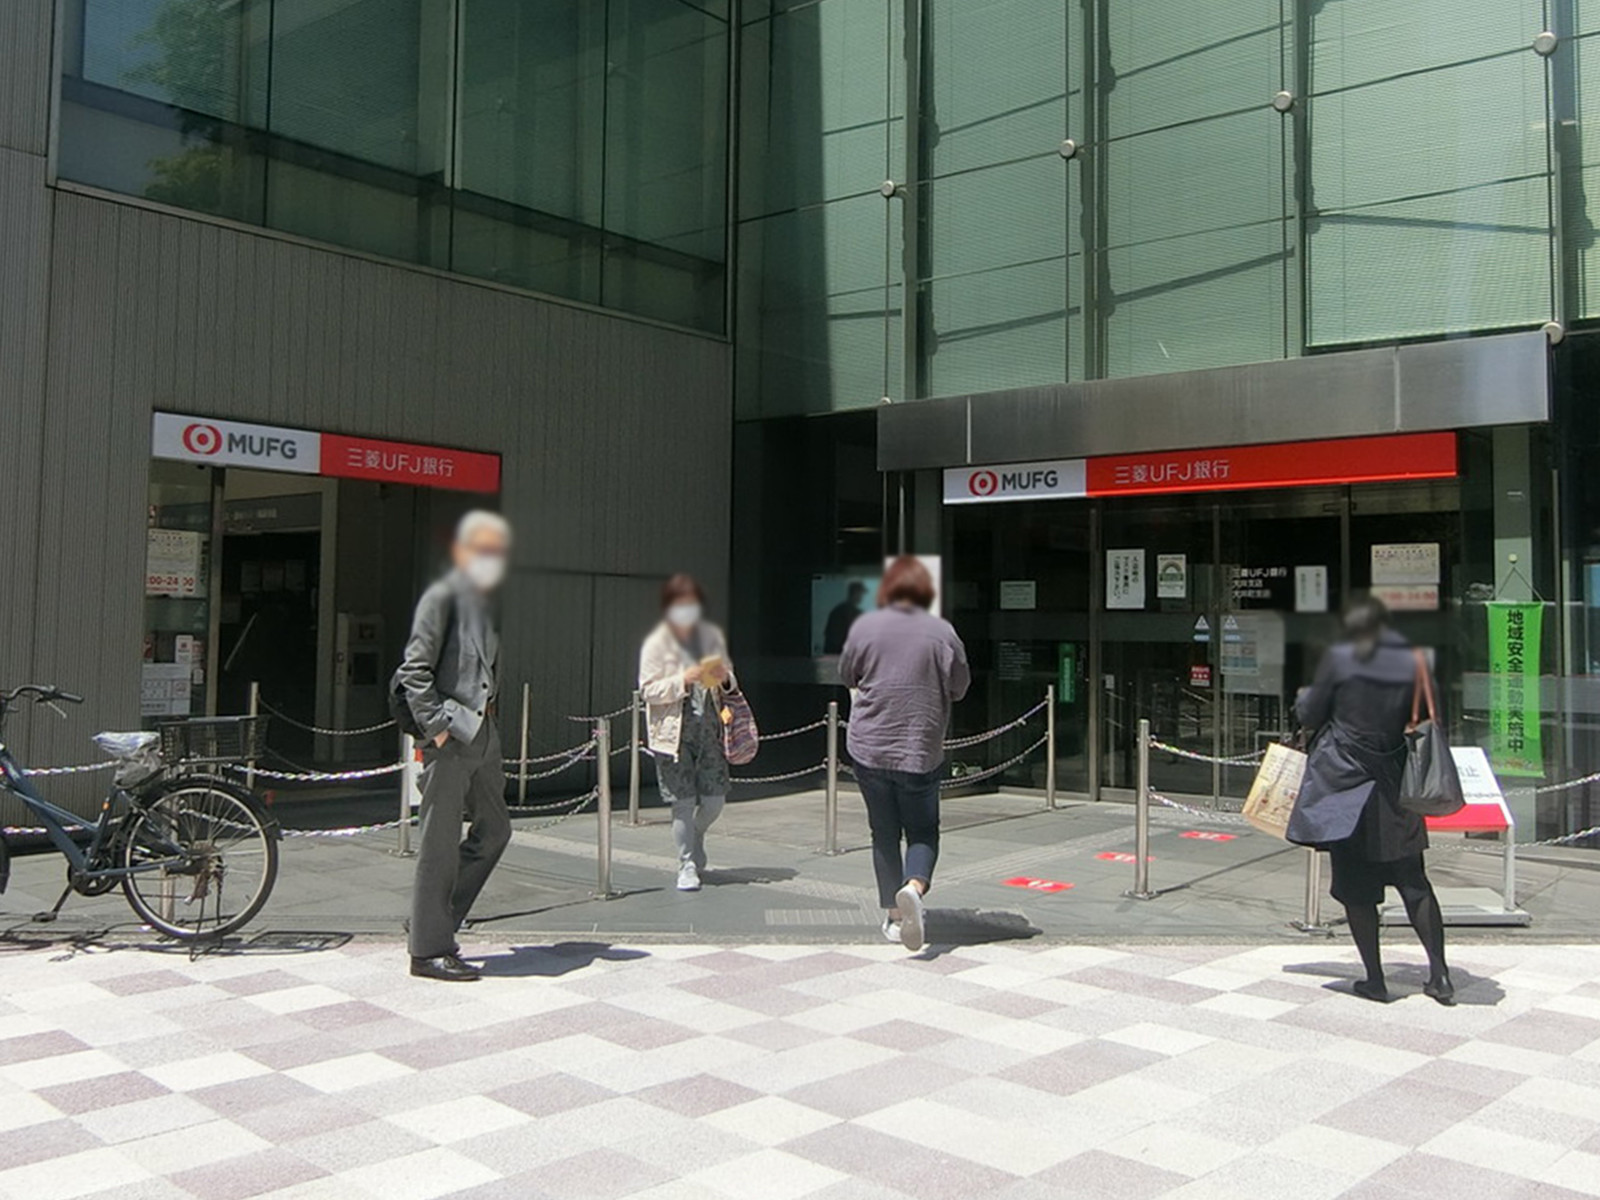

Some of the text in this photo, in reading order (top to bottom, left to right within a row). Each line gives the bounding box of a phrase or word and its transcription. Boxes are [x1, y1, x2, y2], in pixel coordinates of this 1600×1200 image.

[228, 432, 298, 460] MUFG
[347, 446, 455, 478] 三菱UFJ銀行
[1114, 459, 1230, 484] 三菱UFJ銀行
[1001, 469, 1058, 491] MUFG
[1506, 609, 1524, 753] 地域安全運動実施中
